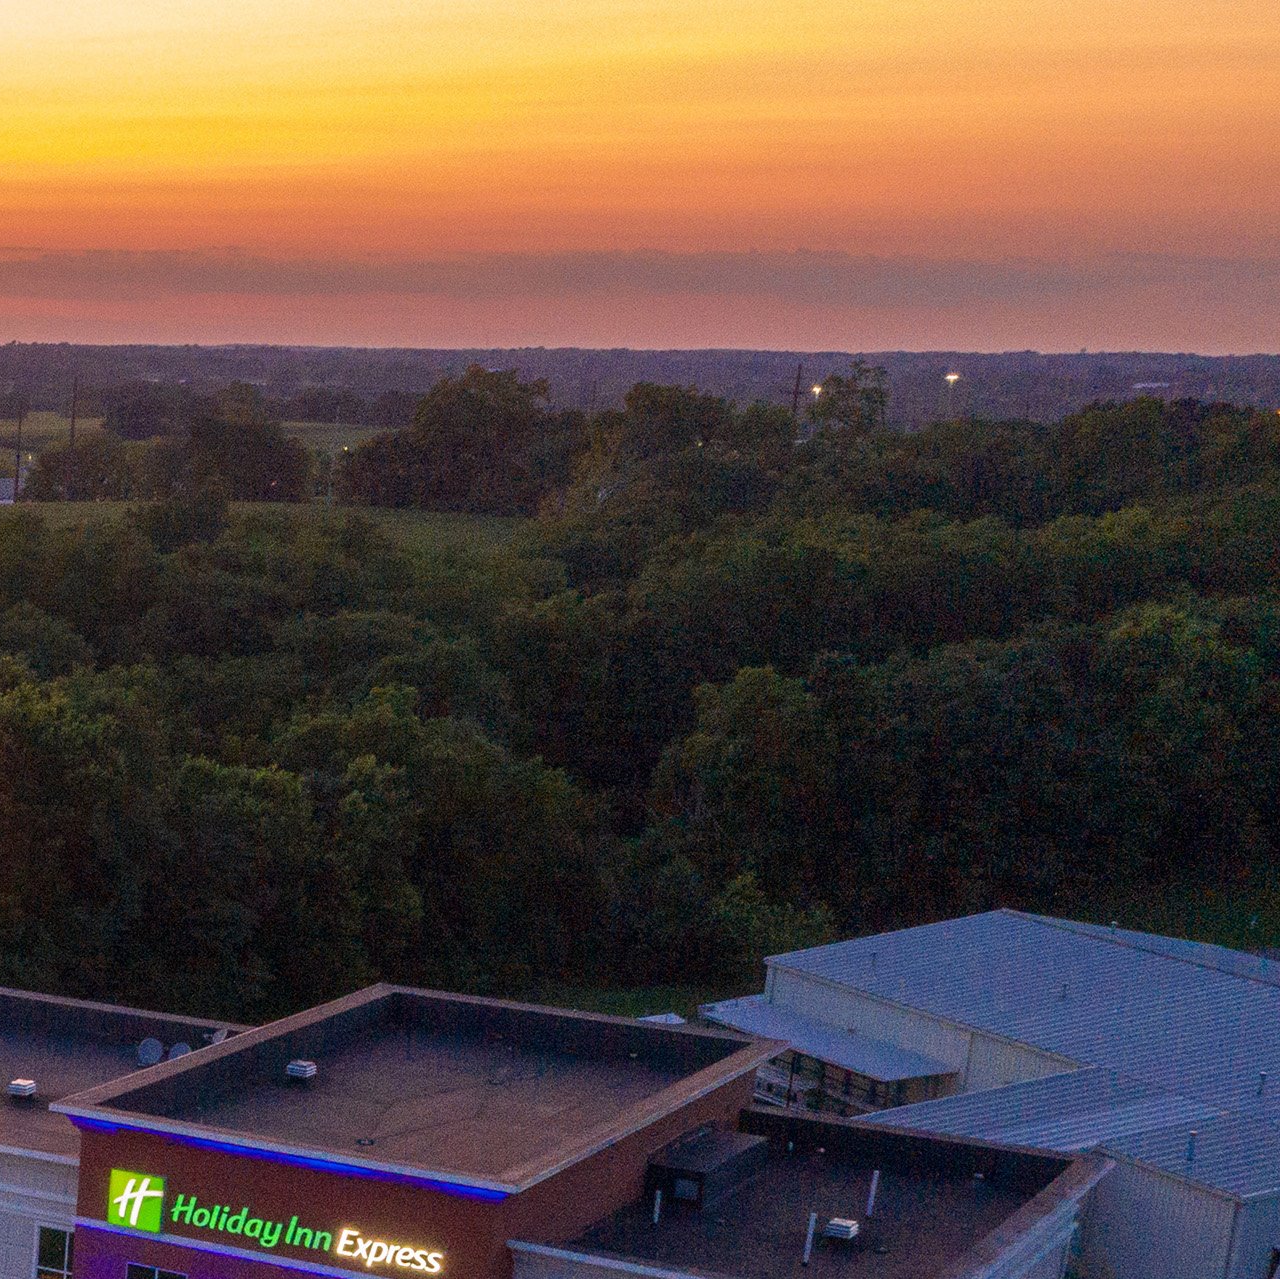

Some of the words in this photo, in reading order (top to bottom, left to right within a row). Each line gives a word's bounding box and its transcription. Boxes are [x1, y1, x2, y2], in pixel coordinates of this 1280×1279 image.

[170, 1194, 282, 1248] Holiday
[285, 1216, 332, 1251] Inn
[336, 1228, 443, 1274] Express
